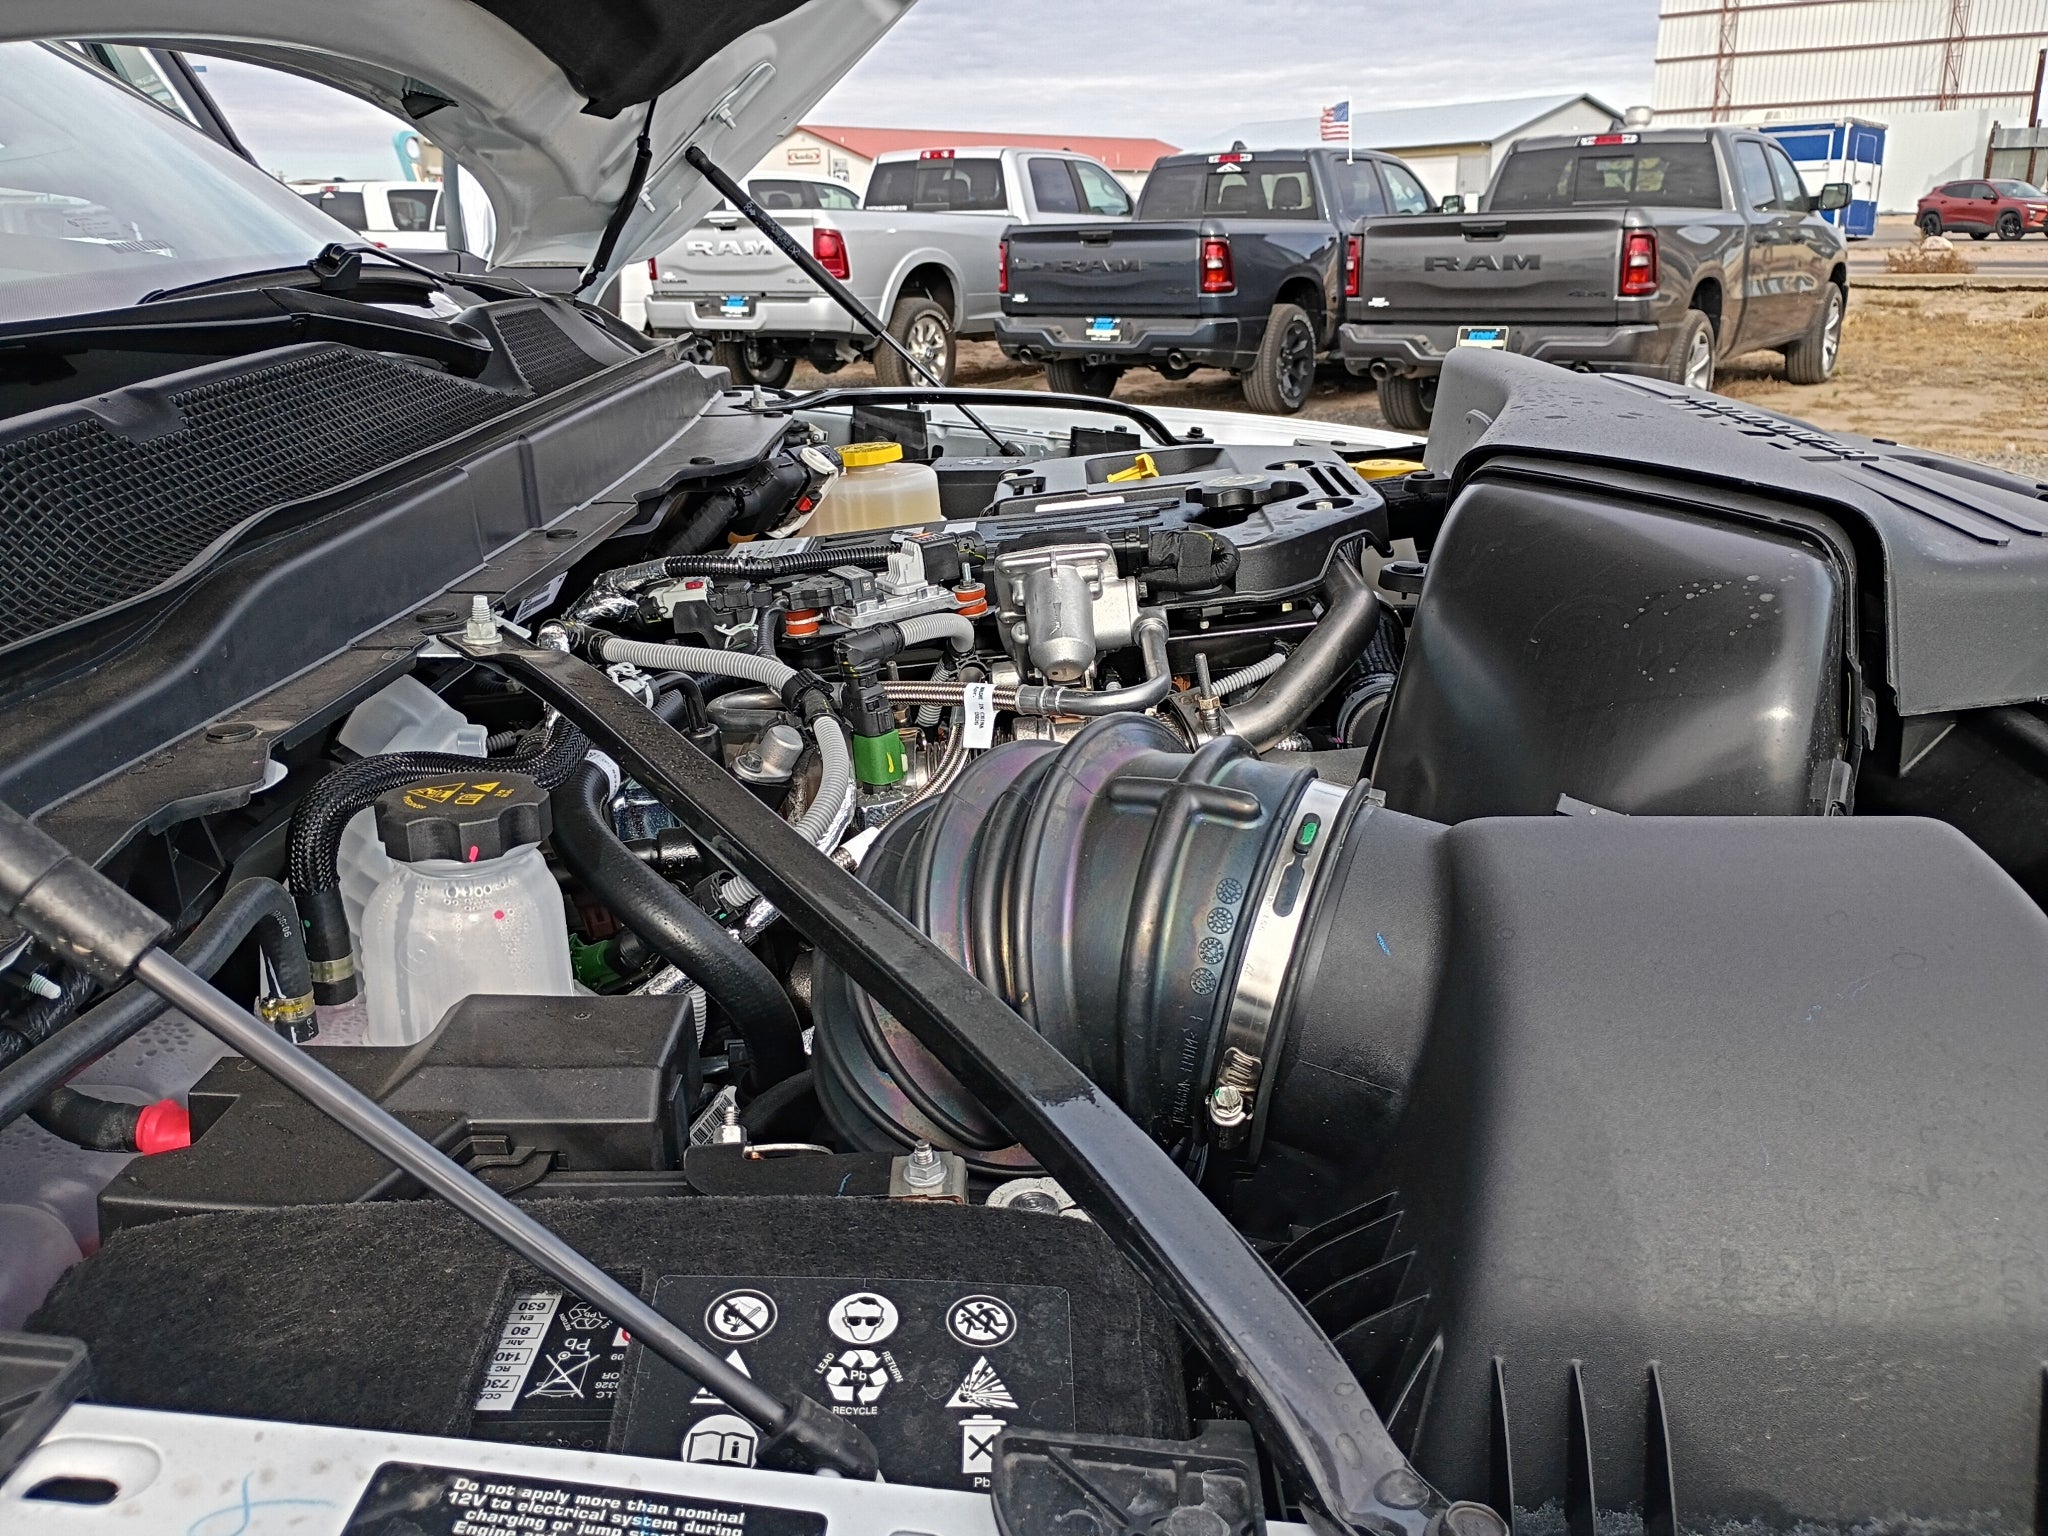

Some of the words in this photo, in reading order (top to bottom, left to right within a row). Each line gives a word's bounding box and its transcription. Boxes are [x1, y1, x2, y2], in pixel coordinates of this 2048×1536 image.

[686, 240, 774, 256] RAM
[1055, 259, 1143, 272] RAM
[1425, 254, 1541, 272] RAM
[518, 1302, 546, 1311] 630
[511, 1326, 531, 1335] 80
[564, 1338, 591, 1350] Pb
[495, 1351, 521, 1362] 140
[814, 1352, 835, 1374] LEAD
[881, 1350, 904, 1383] RETURN
[850, 1370, 867, 1380] Pb
[484, 1379, 510, 1388] 730
[832, 1406, 878, 1415] RECYCLE
[974, 1477, 991, 1488] Pb
[454, 1477, 480, 1491] Do
[484, 1484, 517, 1496] not
[521, 1488, 571, 1504] apply
[575, 1495, 621, 1508] more
[627, 1499, 669, 1515] than
[674, 1506, 746, 1525] nominal
[449, 1491, 488, 1507] 12V
[490, 1498, 512, 1510] to
[517, 1501, 606, 1521] electrical
[610, 1512, 678, 1530] system
[684, 1521, 743, 1536] during
[452, 1520, 517, 1536] Engine
[465, 1508, 548, 1531] charging
[551, 1521, 573, 1532] or
[577, 1521, 623, 1536] jump
